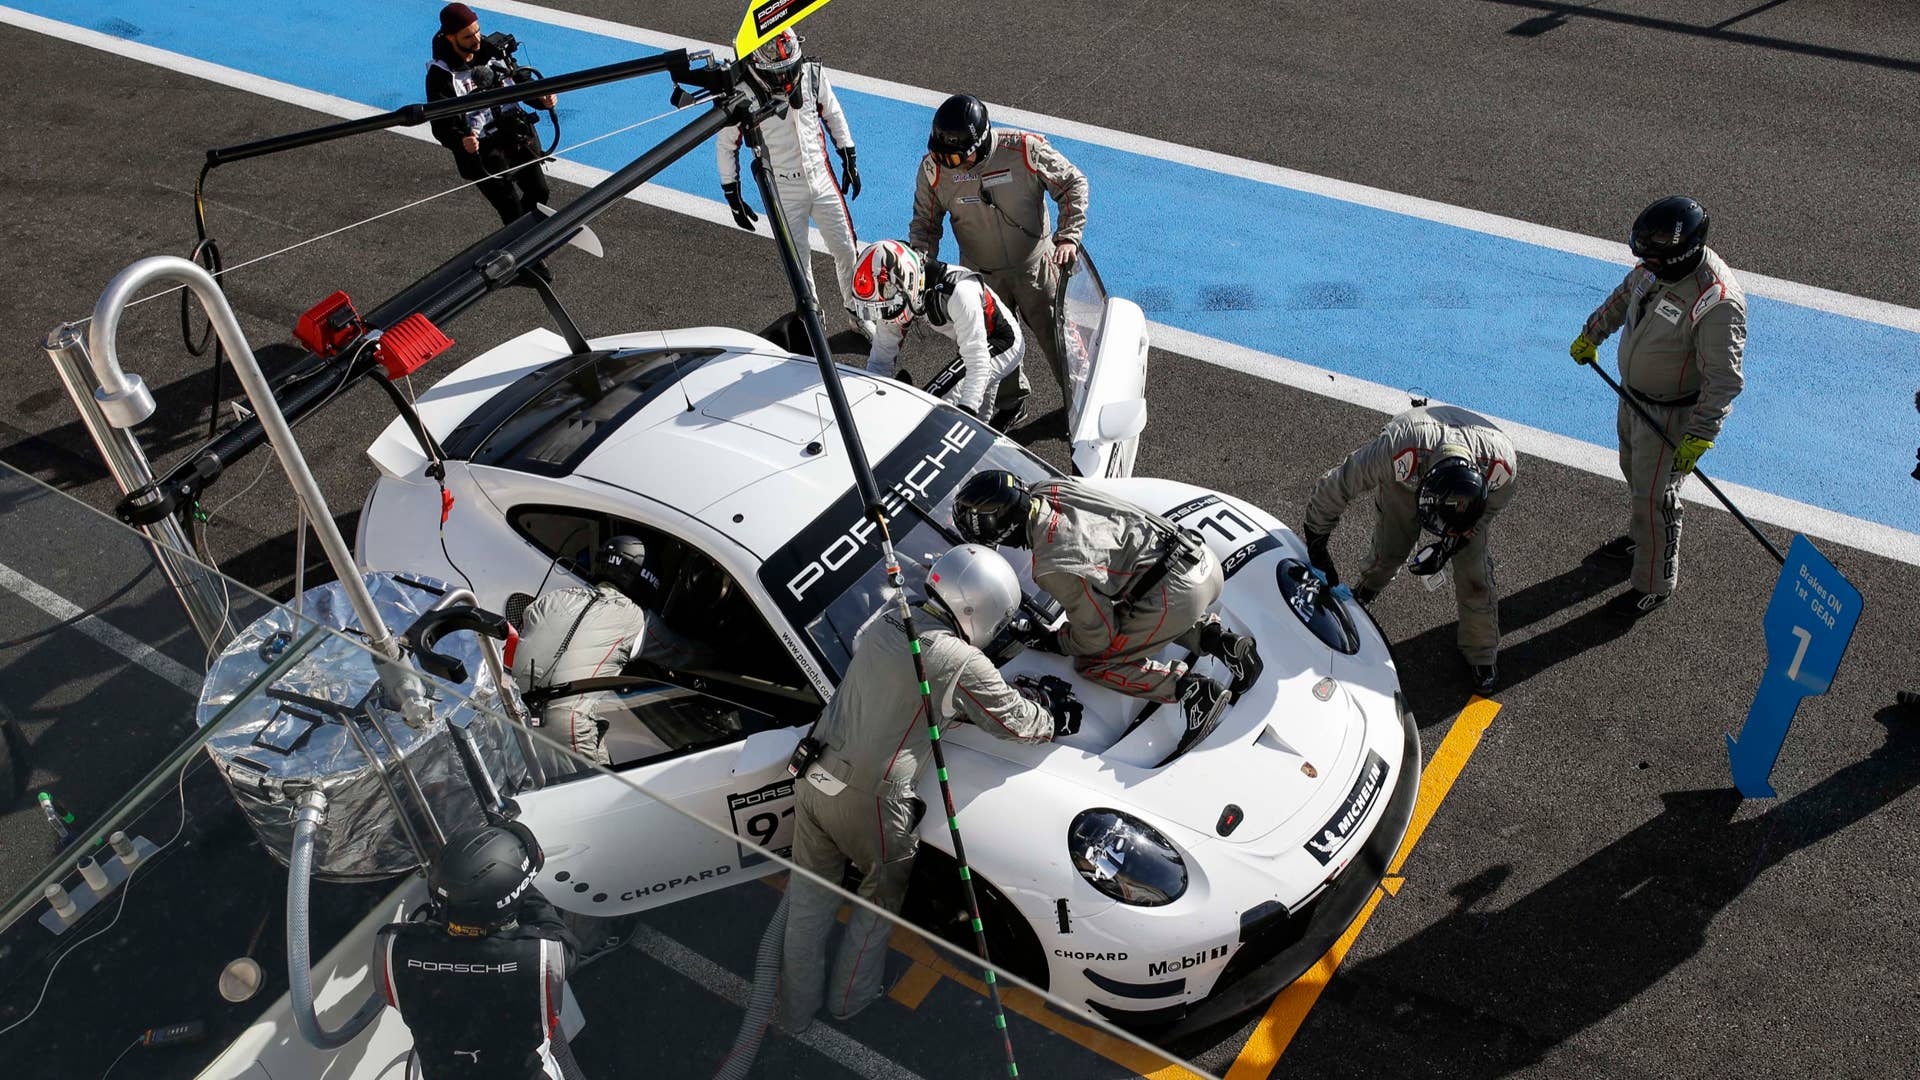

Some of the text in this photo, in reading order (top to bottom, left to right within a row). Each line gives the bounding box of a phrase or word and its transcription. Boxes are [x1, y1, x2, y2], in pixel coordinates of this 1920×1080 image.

[1672, 221, 1684, 245] uvex
[1666, 243, 1701, 265] uvex
[1224, 543, 1258, 573] RSR
[1799, 563, 1843, 615] Brakes ON
[1794, 580, 1836, 631] 1st GEAR
[1787, 624, 1812, 681] 1
[731, 782, 796, 809] PORS
[1337, 762, 1381, 836] MICHELIN
[496, 866, 537, 909] uvex
[620, 865, 732, 901] CHOPARD
[408, 959, 518, 973] PORSCHE
[1054, 949, 1129, 961] CHOPARD
[1149, 950, 1206, 977] Mobil
